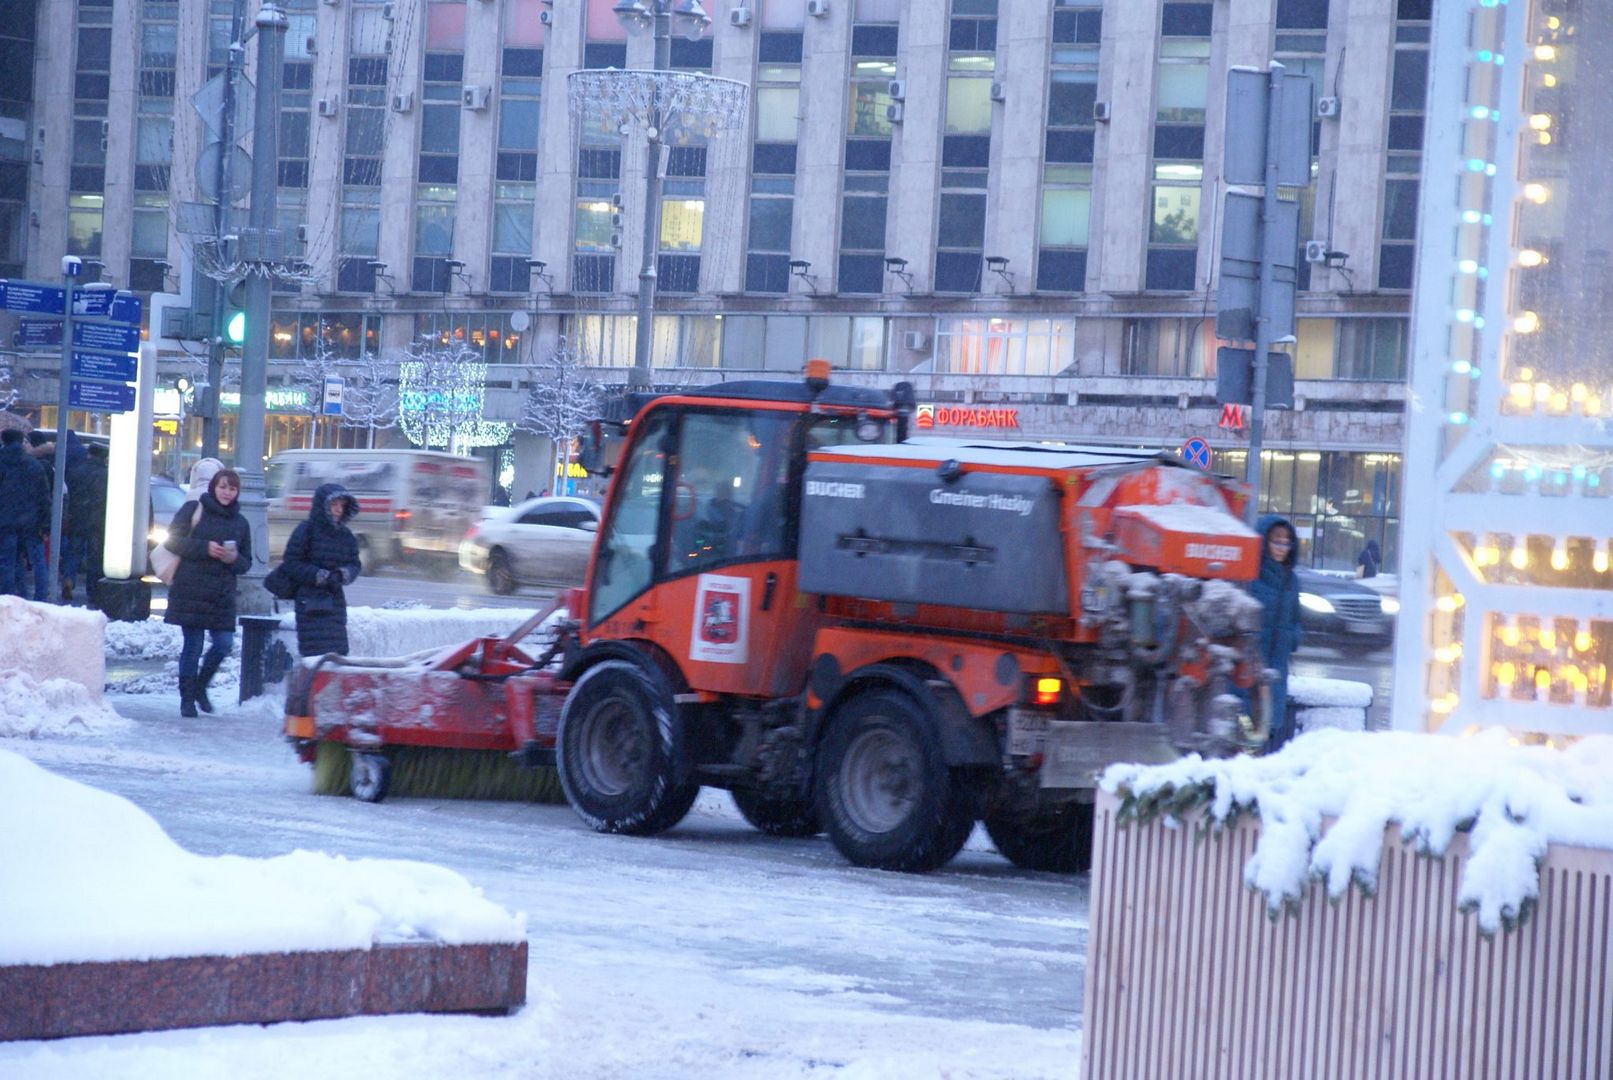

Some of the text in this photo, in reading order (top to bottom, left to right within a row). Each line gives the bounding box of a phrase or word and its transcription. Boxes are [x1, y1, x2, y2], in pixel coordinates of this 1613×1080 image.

[937, 407, 1018, 428] ФОРАБАНК
[806, 481, 865, 498] BUCHER
[1184, 543, 1242, 561] BUCHER
